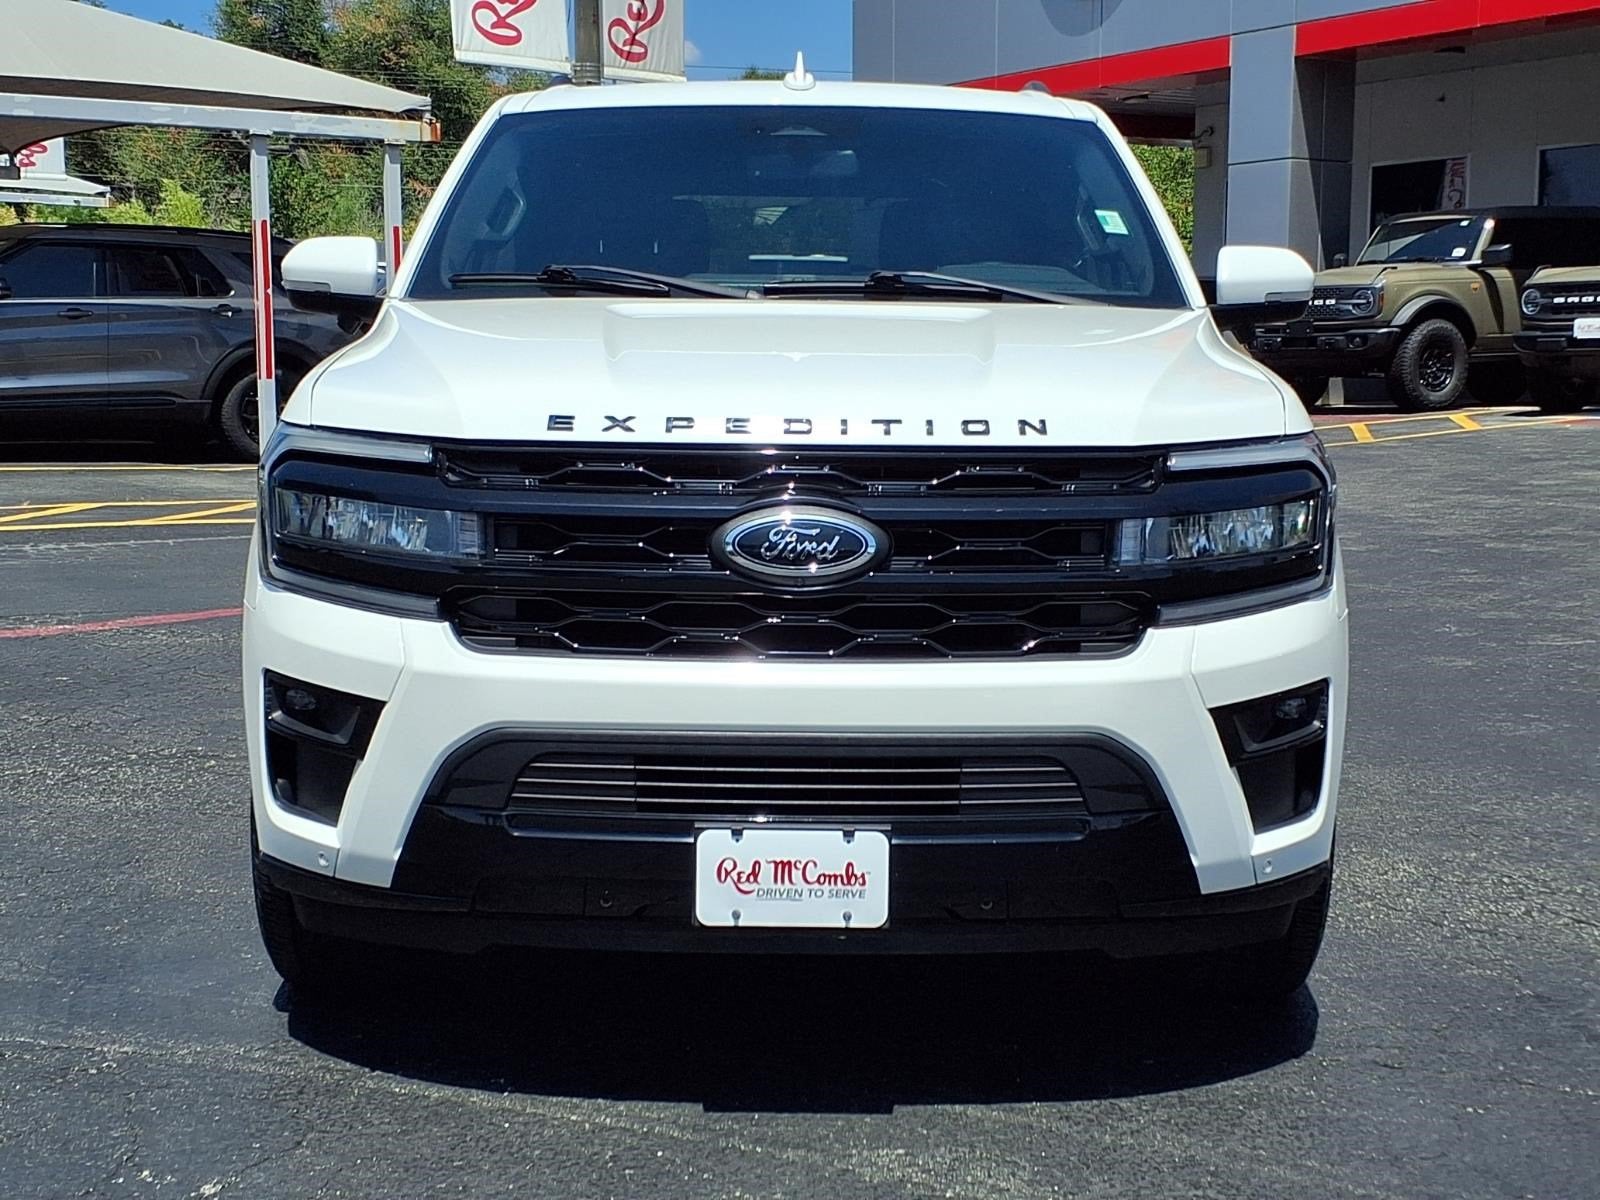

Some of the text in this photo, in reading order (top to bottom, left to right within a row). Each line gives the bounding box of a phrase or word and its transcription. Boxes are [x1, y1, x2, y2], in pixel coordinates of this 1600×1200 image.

[607, 0, 665, 63] Re
[546, 414, 1048, 436] EXPEDITION
[760, 525, 840, 560] Ford
[716, 856, 867, 895] Red McCombs
[756, 887, 867, 899] DRIVEN TO SERVE
